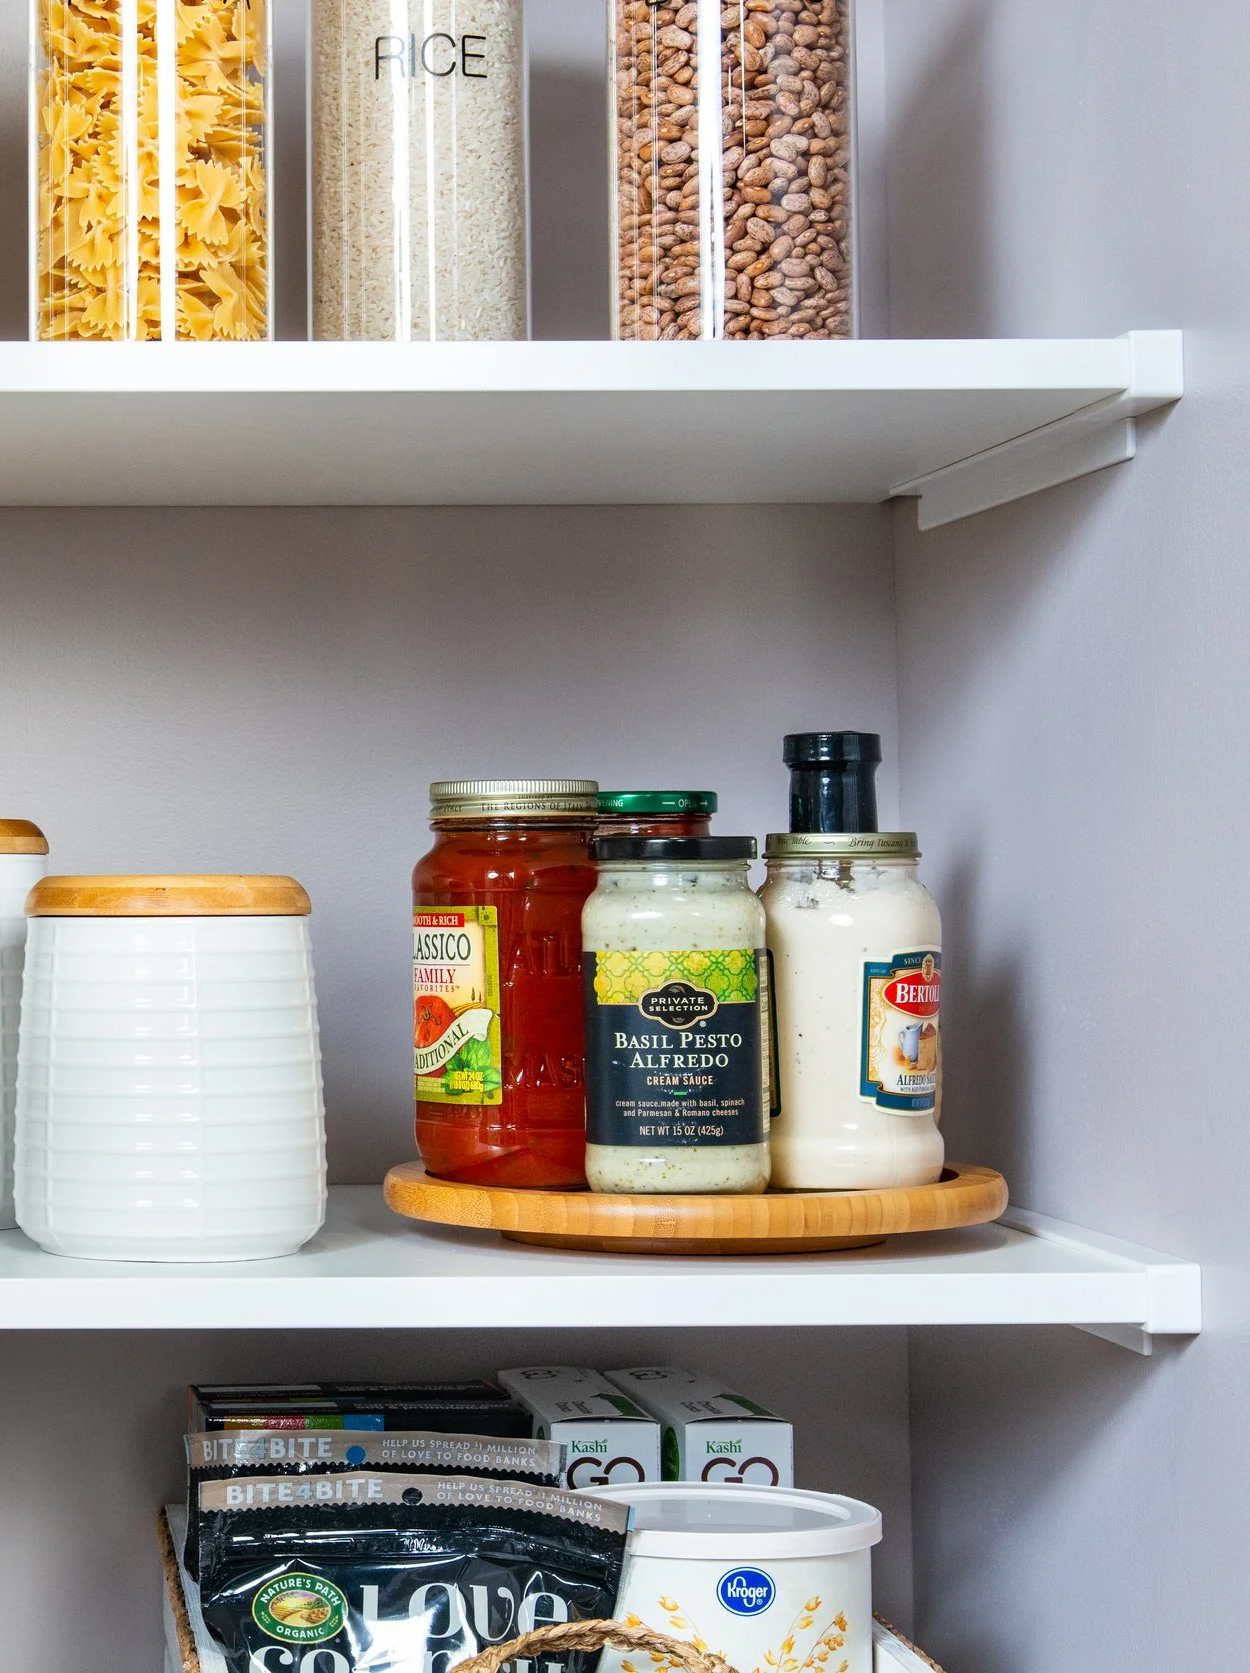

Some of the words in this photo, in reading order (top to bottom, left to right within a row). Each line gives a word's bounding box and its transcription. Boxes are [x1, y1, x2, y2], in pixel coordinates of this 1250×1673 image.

[375, 33, 488, 79] RICE
[481, 803, 498, 811] THE
[504, 802, 546, 811] REGIONS
[550, 802, 560, 810] OF
[563, 802, 583, 811] ITALY
[791, 835, 812, 845] Table
[848, 836, 874, 850] Bring
[432, 916, 438, 925] &
[439, 915, 458, 926] RICH
[414, 968, 456, 984] FAMILY
[414, 1022, 469, 1069] ADITIONAL
[614, 1032, 674, 1049] BASIL
[679, 1032, 742, 1048] PESTO
[630, 1051, 729, 1068] ALFREDO
[646, 1076, 679, 1085] CREAM
[683, 1075, 714, 1085] SAUCE
[660, 1099, 679, 1107] made
[682, 1099, 697, 1107] with
[699, 1099, 719, 1107] basil,
[721, 1098, 745, 1109] spinach
[712, 1108, 738, 1116] cheeses
[639, 1126, 655, 1136] NET
[657, 1126, 669, 1136] WT
[673, 1126, 682, 1136] 15
[684, 1126, 695, 1136] OZ
[698, 1126, 724, 1137] (425g)
[203, 1437, 332, 1461] BITE4BITE
[383, 1439, 408, 1447] HELP
[412, 1439, 425, 1447] US
[430, 1440, 470, 1450] SPREAD
[487, 1444, 536, 1455] MILLION
[572, 1439, 607, 1453] Kashi
[706, 1439, 742, 1453] Kashi
[382, 1450, 396, 1458] OF
[401, 1450, 431, 1459] LOVE
[436, 1451, 452, 1460] TO
[457, 1452, 490, 1463] FOOD
[496, 1456, 535, 1467] BANKS
[226, 1479, 383, 1504] BITE4BITE
[437, 1482, 465, 1490] HELP
[470, 1483, 484, 1491] US
[489, 1485, 533, 1497] SPREAD
[550, 1494, 602, 1512] MILLION
[459, 1492, 490, 1502] LOVE
[496, 1495, 513, 1504] TO
[518, 1498, 553, 1510] FOOD
[560, 1505, 600, 1522] BANKS
[260, 1578, 311, 1603] NATURE'S
[315, 1582, 341, 1606] PATH
[727, 1576, 768, 1607] Kroger
[276, 1625, 324, 1638] ORGANIC
